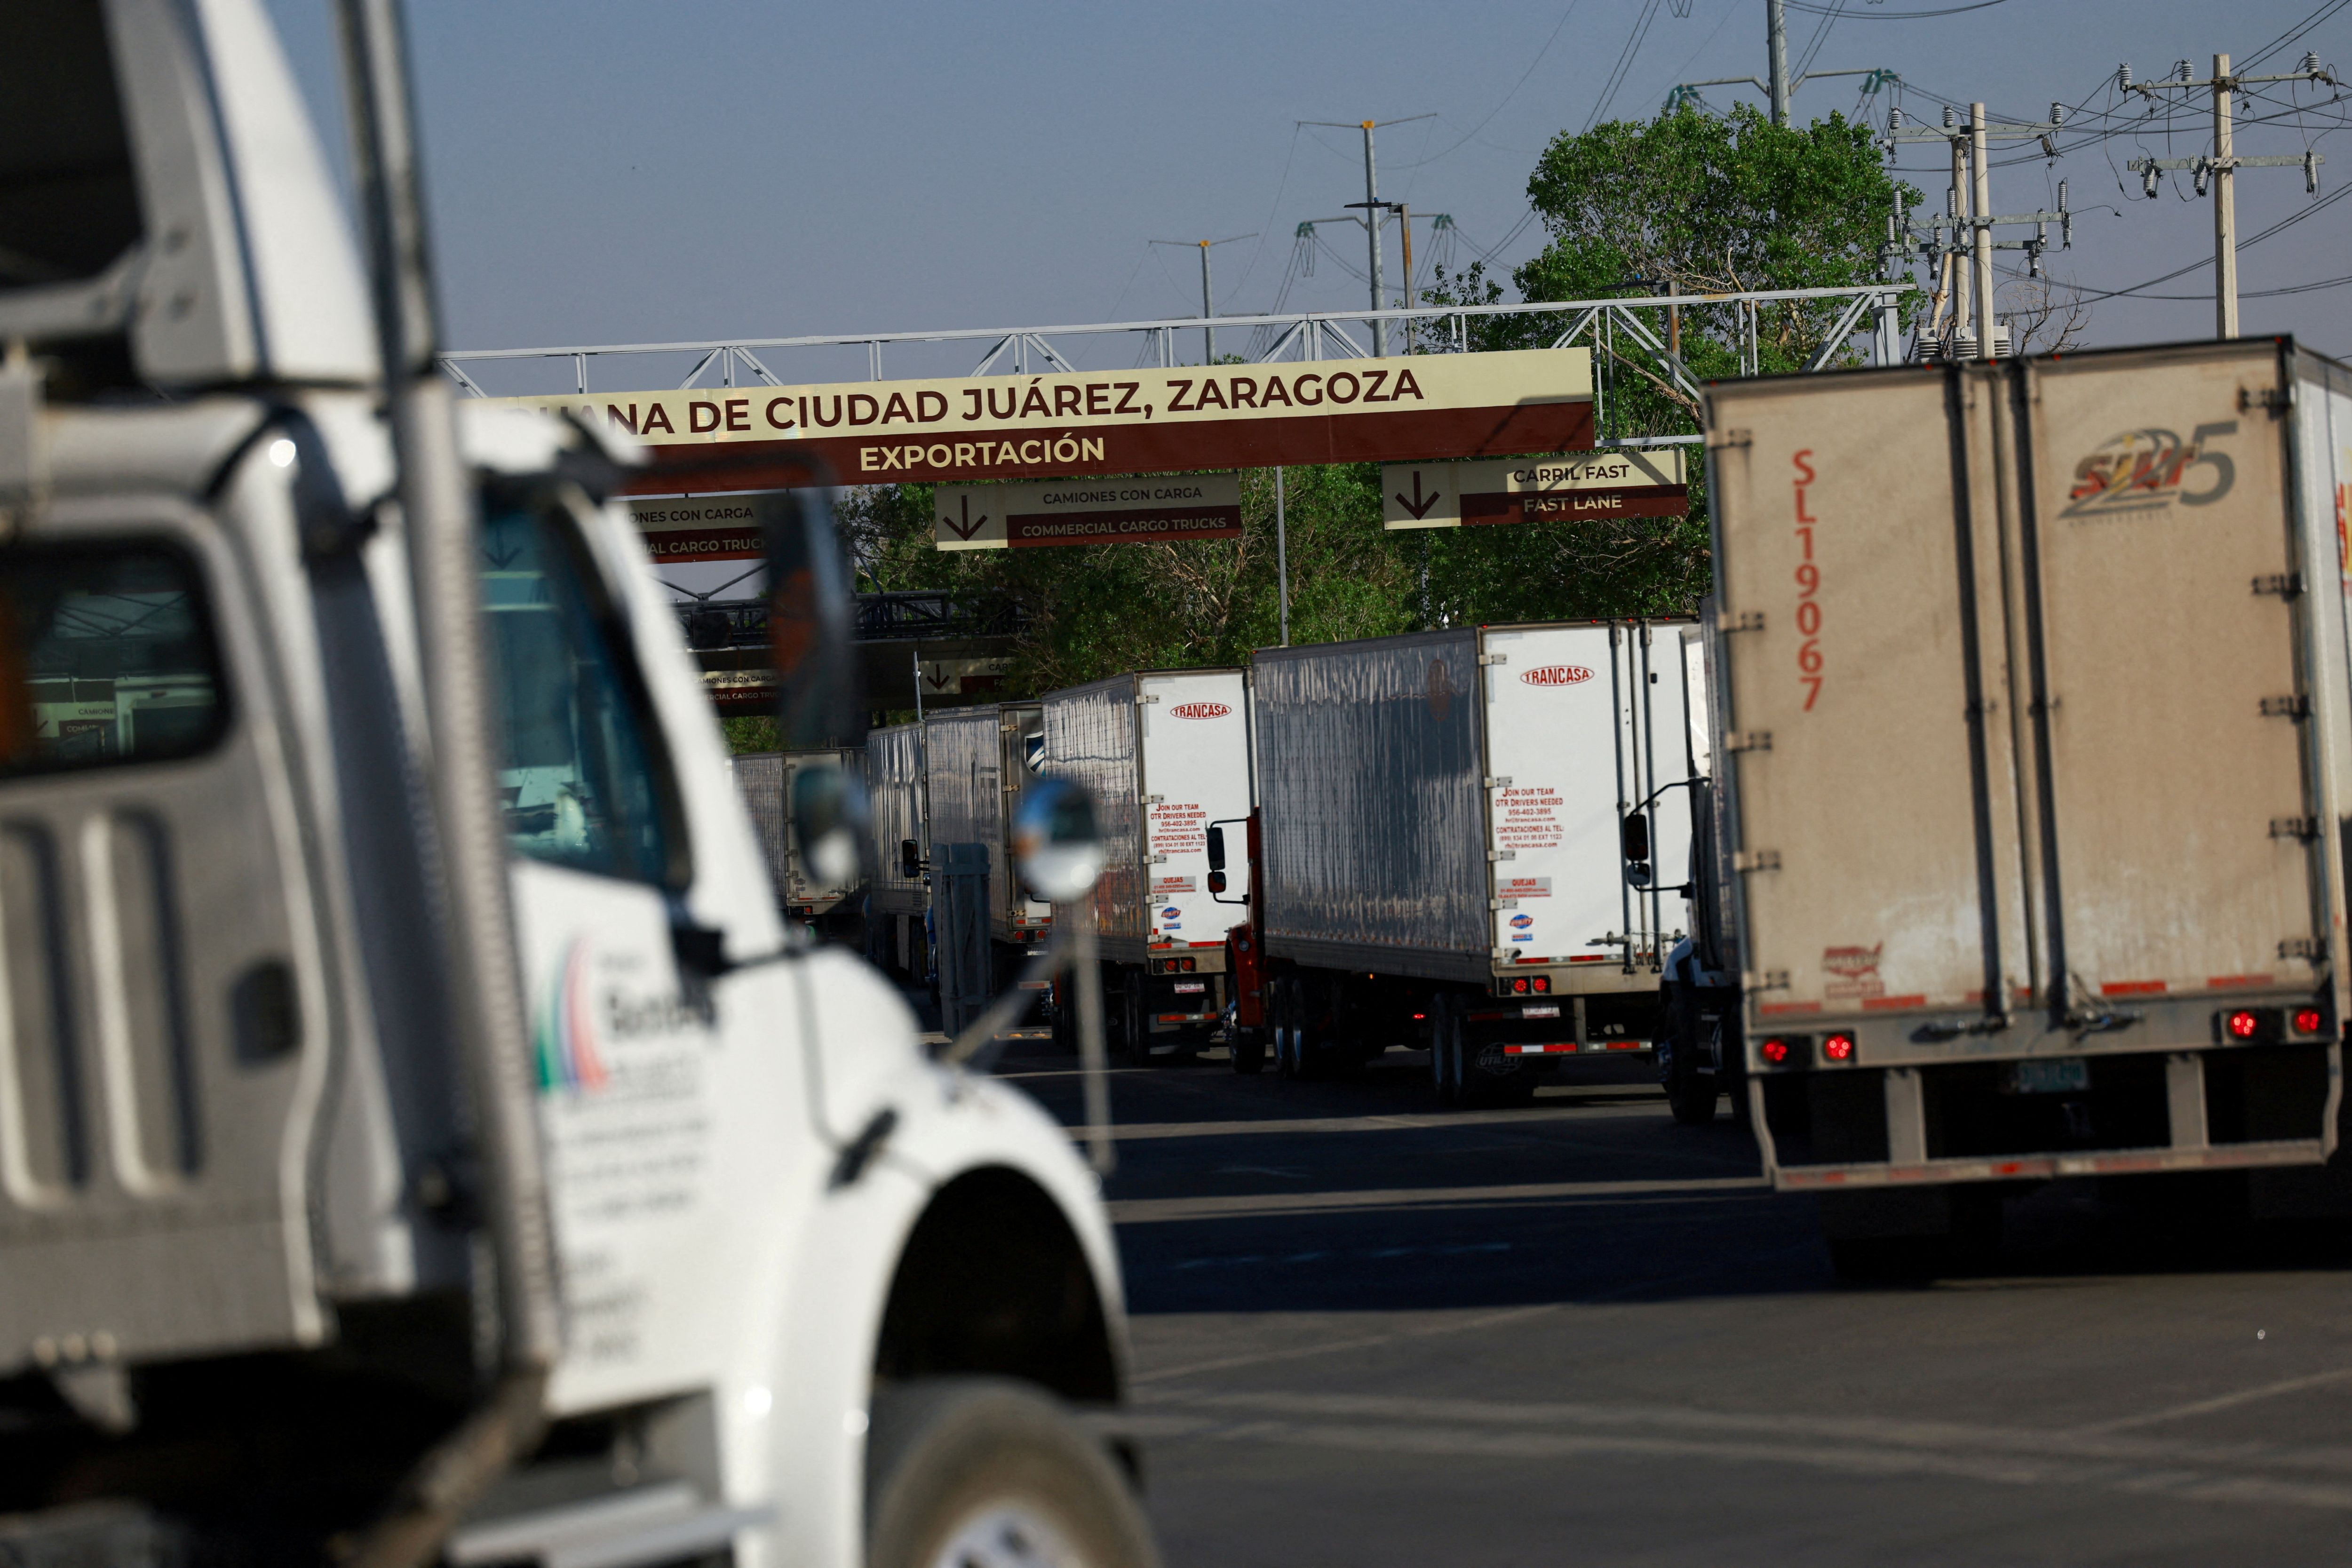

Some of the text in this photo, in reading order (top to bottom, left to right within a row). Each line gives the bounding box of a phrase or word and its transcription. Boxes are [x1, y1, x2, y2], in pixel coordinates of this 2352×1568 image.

[689, 399, 751, 433] DE
[765, 391, 948, 430] CIUDAD
[961, 377, 1153, 421] JUÁREZ,
[1167, 369, 1424, 412] ZARAGOZA
[860, 432, 1104, 471] EXPORTACIÓN
[1513, 465, 1629, 483] CARRIL FAST
[1043, 487, 1202, 504] CAMIONES CON CARGA
[1524, 494, 1622, 512] FAST LANE
[670, 509, 700, 521] CON
[705, 507, 754, 520] CARGA
[1022, 517, 1227, 537] COMMERCIAL CARGO TRUCKS
[669, 540, 720, 554] CARGO
[1525, 668, 1589, 684] TRANCASA
[1174, 704, 1228, 718] TRANCASA
[1495, 826, 1543, 834] CONTRATACIONES
